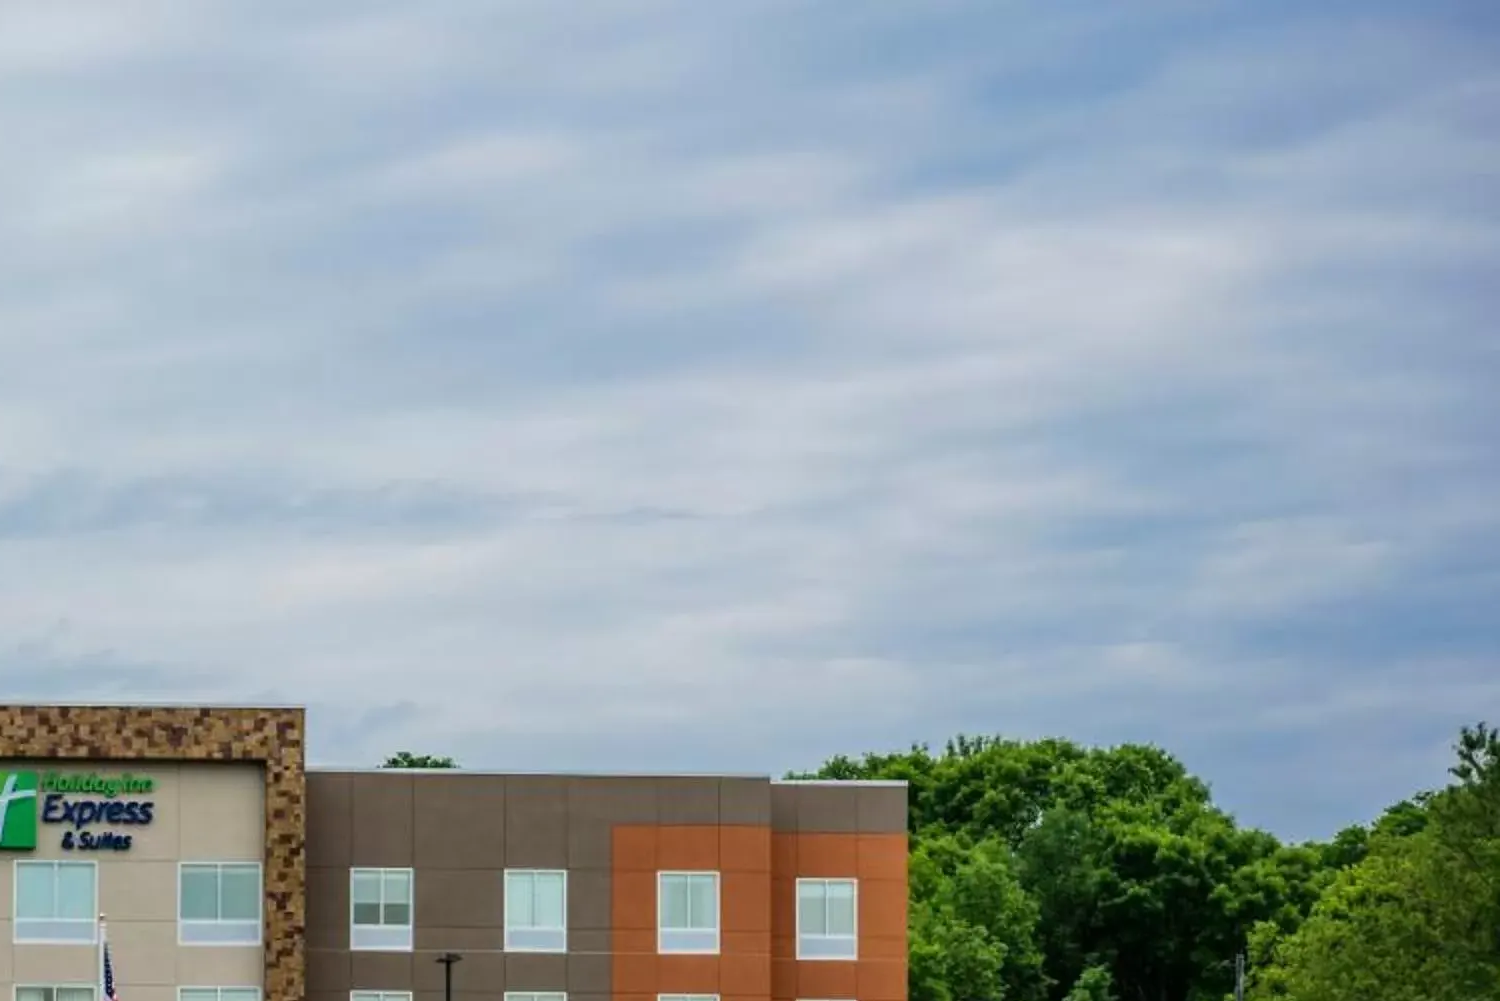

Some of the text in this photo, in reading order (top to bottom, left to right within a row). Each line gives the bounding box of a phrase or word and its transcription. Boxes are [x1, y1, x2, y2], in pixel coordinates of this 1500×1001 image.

[41, 773, 155, 798] Holiday Inn
[42, 793, 155, 830] Express
[61, 831, 132, 850] & Suites
